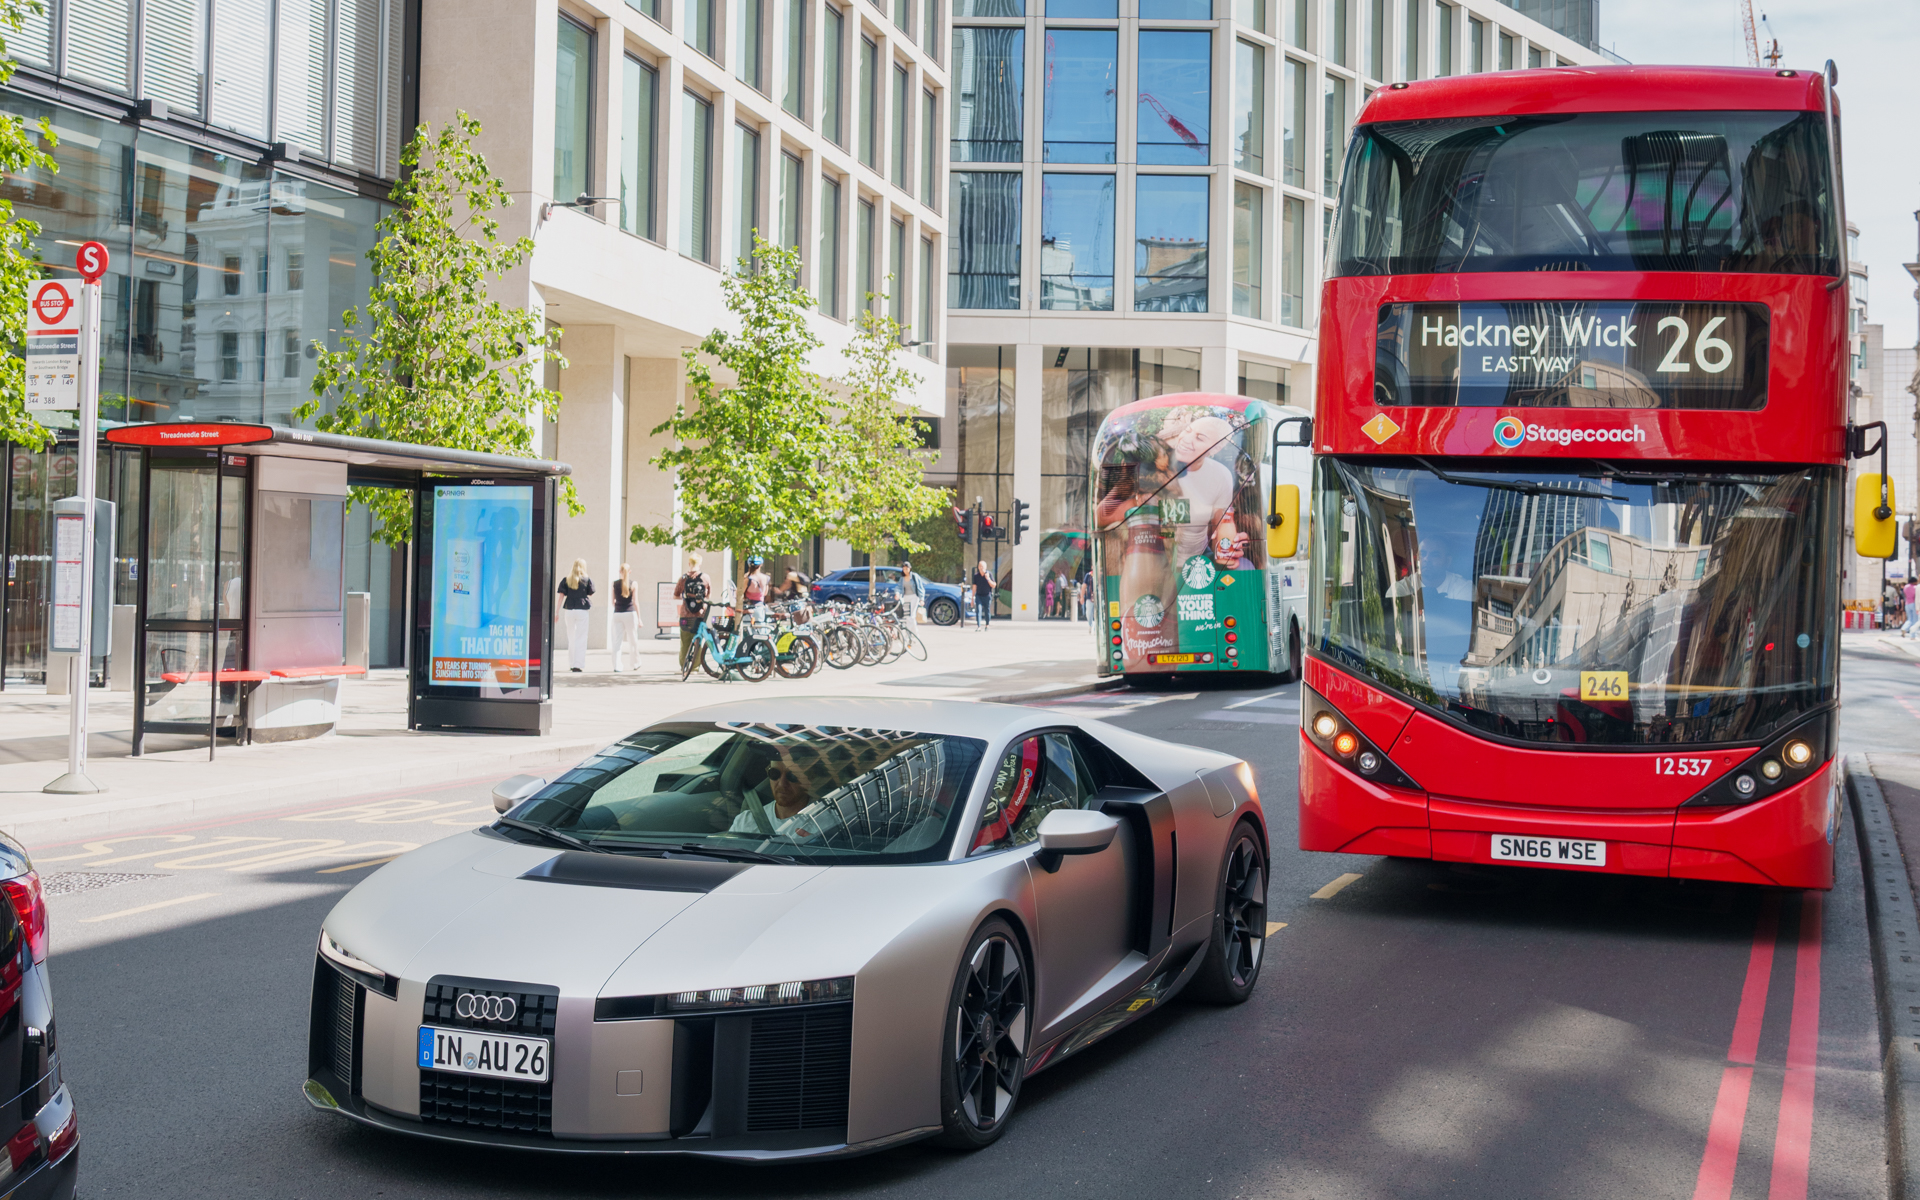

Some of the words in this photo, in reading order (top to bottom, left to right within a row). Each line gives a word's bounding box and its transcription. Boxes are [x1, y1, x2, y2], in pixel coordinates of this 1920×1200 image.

[84, 246, 99, 273] S
[1421, 314, 1551, 357] Hackney
[1559, 315, 1637, 348] Wick
[1656, 316, 1733, 374] 26
[1482, 356, 1575, 374] EASTWAY
[160, 431, 200, 439] Threadneedle
[200, 430, 219, 438] Street
[1526, 424, 1645, 448] Stagecoach
[437, 489, 466, 497] GARNIER
[1163, 502, 1186, 522] 149
[454, 582, 463, 591] 50
[1178, 600, 1214, 611] YOUR
[489, 624, 502, 636] TAG
[504, 625, 514, 637] ME
[516, 625, 523, 637] IN
[1195, 622, 1213, 632] we're
[460, 637, 491, 654] THAT
[494, 638, 523, 656] ONE!
[436, 660, 443, 669] 90
[444, 661, 460, 670] YEARS
[468, 662, 491, 670] TURNING
[436, 670, 460, 678] SUNSHINE
[1588, 677, 1622, 697] 246
[1655, 758, 1712, 777] 12537
[34, 834, 422, 872] STOP
[1500, 838, 1552, 858] SN66
[1558, 841, 1597, 861] WSE
[423, 1051, 429, 1060] D
[435, 1034, 462, 1066] IN
[478, 1040, 508, 1072] AU
[515, 1044, 544, 1075] 26
